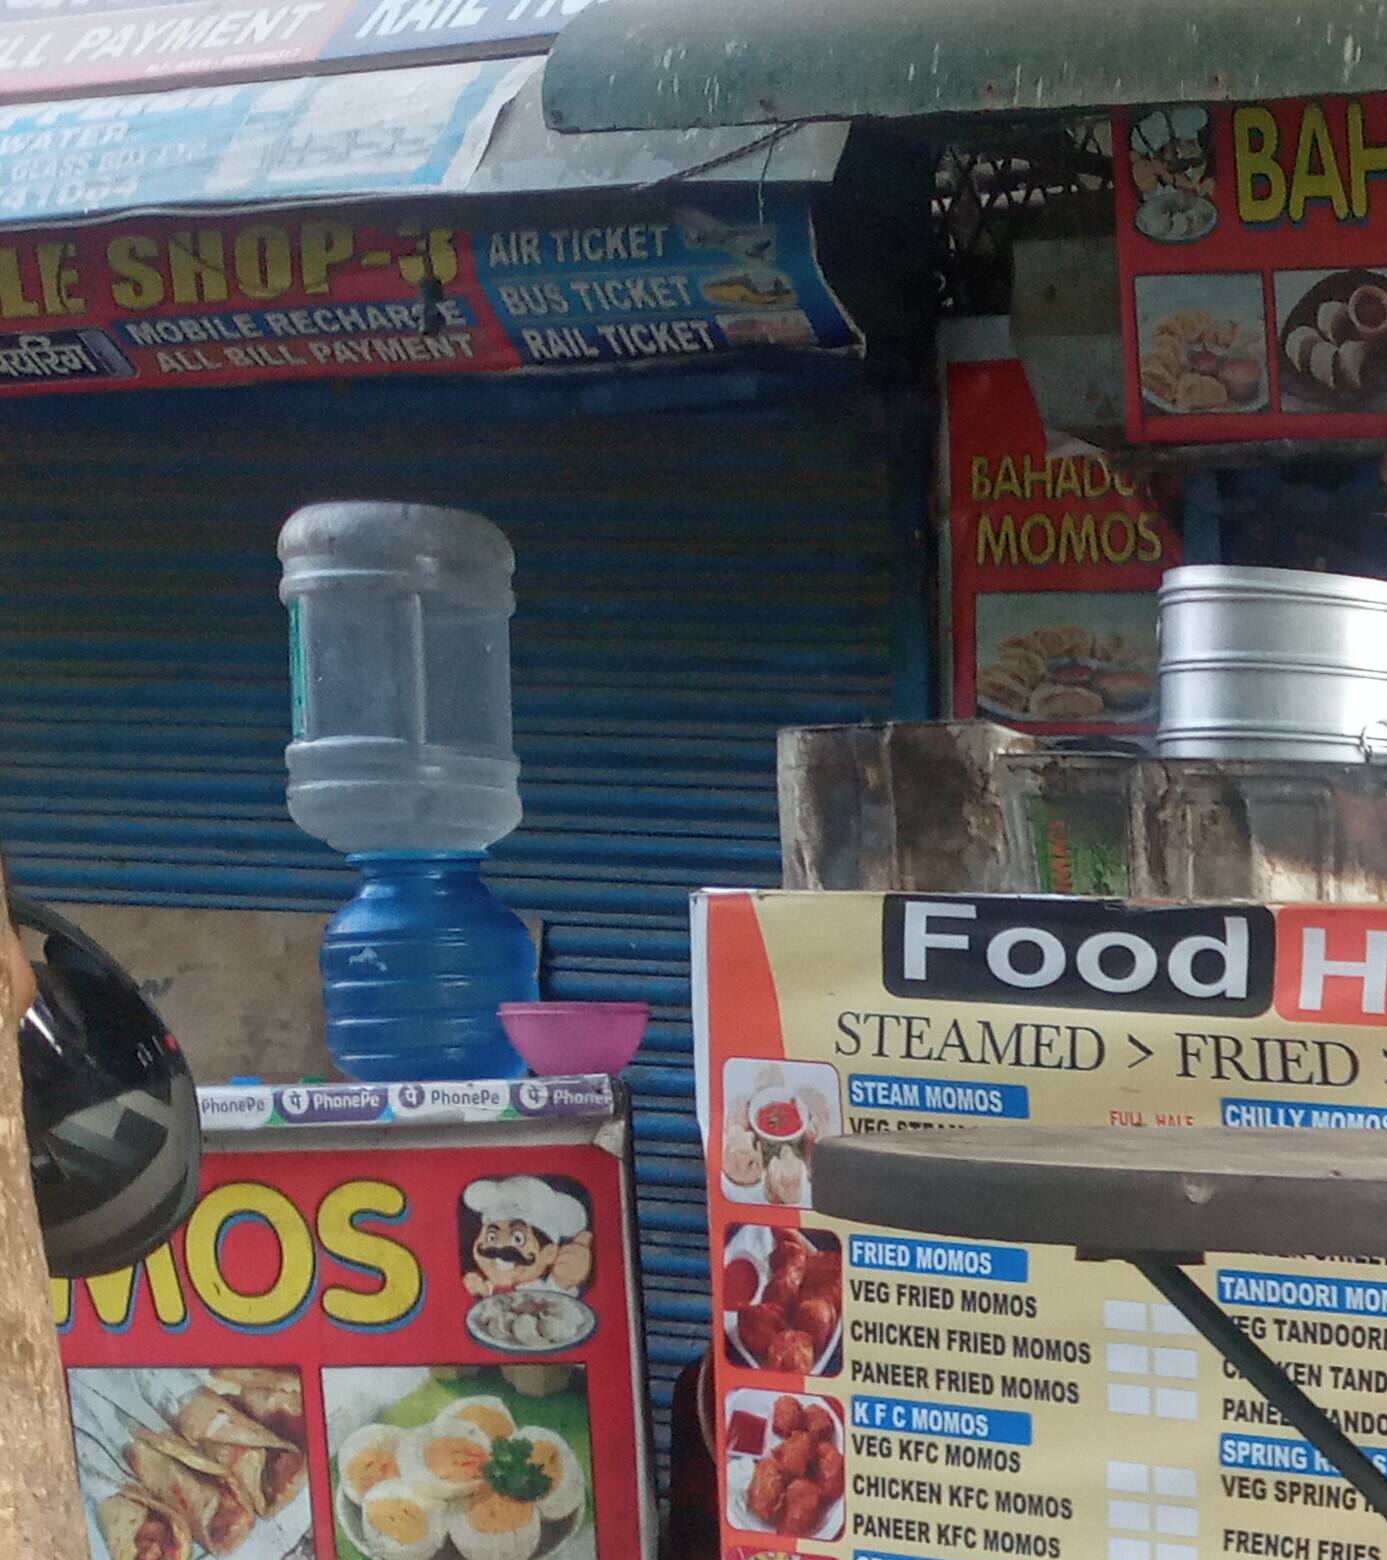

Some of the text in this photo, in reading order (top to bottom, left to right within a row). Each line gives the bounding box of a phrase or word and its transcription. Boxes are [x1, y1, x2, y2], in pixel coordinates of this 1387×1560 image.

[62, 2, 328, 63] PAYMENT
[487, 223, 670, 268] AIR TICKET
[499, 275, 692, 317] BUS TICKET
[125, 312, 263, 346] MOBILE
[521, 319, 717, 360] RAIL TICKET
[156, 332, 474, 373] ALL BILL PAYMENT
[976, 511, 1163, 566] MOMOS
[902, 900, 1250, 1000] Food
[834, 1011, 1105, 1072] STEAMED
[1175, 1031, 1361, 1087] FRIED
[201, 1098, 265, 1114] PhonePe
[313, 1088, 380, 1110] PhonePe
[430, 1088, 500, 1106] PhonePe
[851, 1080, 1003, 1113] STEAM MOMOS
[1225, 1104, 1305, 1128] CHILLY
[851, 1239, 993, 1276] FRIED MOMOS
[850, 1279, 1038, 1319] VEG FRIED MOMOS
[1219, 1276, 1338, 1309] TANDOORI
[850, 1319, 1092, 1365] CHICKEN FRIED MOMOS
[1232, 1315, 1267, 1340] EG
[850, 1359, 1081, 1405] PANEER FRIED MOMOS
[854, 1402, 989, 1438] K F C MOMOS
[851, 1433, 1021, 1473] VEG KFC MOMOS
[1222, 1438, 1308, 1472] SPRING
[852, 1474, 1073, 1521] CHICKEN KFC MOMOS
[1221, 1474, 1267, 1501] VEG
[1274, 1480, 1357, 1511] SPRING
[852, 1513, 1061, 1559] PANEER KFC MOMOS
[1222, 1528, 1310, 1560] FRENCH
